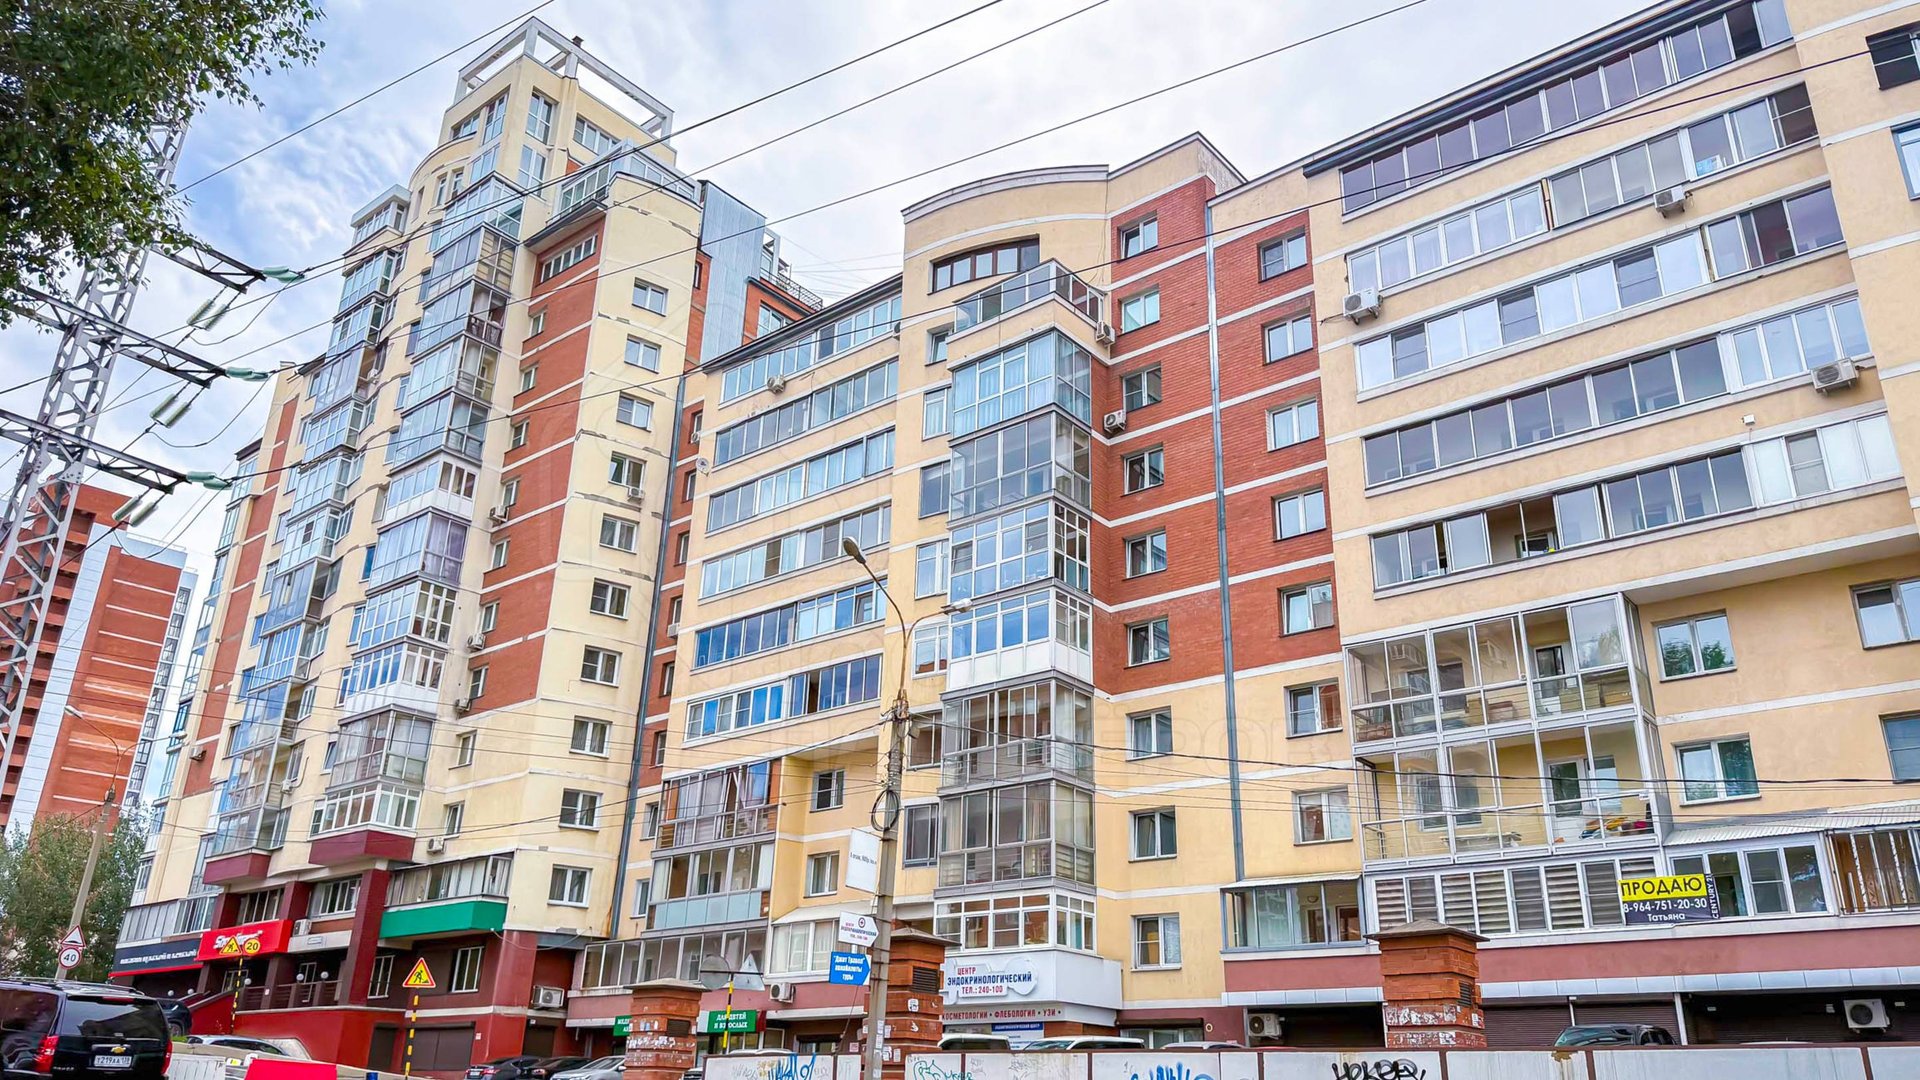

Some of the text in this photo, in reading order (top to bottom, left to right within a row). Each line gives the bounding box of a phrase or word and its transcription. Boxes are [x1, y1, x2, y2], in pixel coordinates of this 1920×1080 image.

[1621, 877, 1702, 896] ПРОДАЮ
[1623, 898, 1707, 913] 8-964-751-20-30
[1707, 883, 1718, 919] CENTURY
[1648, 913, 1685, 921] Татьяна
[246, 942, 258, 951] 20
[63, 953, 77, 962] 40
[957, 967, 976, 975] ЦЕНТР
[947, 972, 1032, 986] ЭНДОКРИНОЛОГИЧЕСКИЙ
[962, 985, 1003, 994] ТЕЛ.: 240-100
[994, 1009, 1036, 1018] ФЛЕБОЛОГИЯ
[1043, 1008, 1056, 1017] УЗИ
